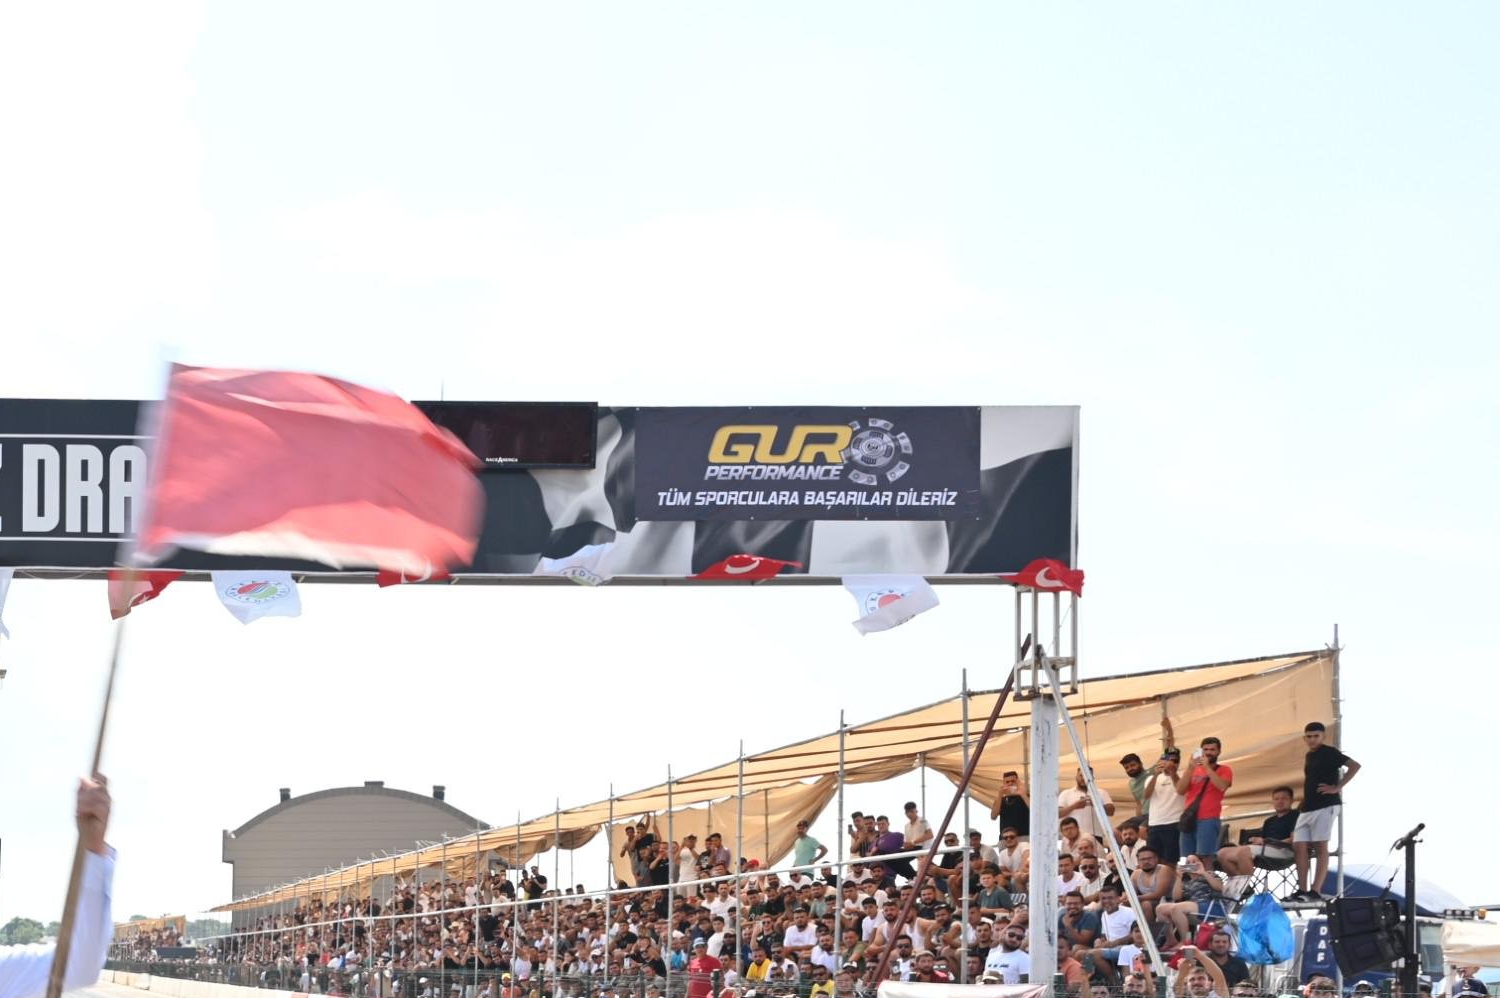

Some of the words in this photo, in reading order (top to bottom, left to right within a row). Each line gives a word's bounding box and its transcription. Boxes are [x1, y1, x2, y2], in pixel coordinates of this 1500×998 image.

[704, 465, 844, 480] PERFORMANCE
[22, 443, 149, 534] DRA
[657, 487, 692, 506] TÜM
[694, 491, 800, 505] SPORCULARA
[803, 491, 893, 509] BAŞARILAR
[896, 487, 958, 506] DİLERİZ
[1316, 926, 1328, 963] DAF
